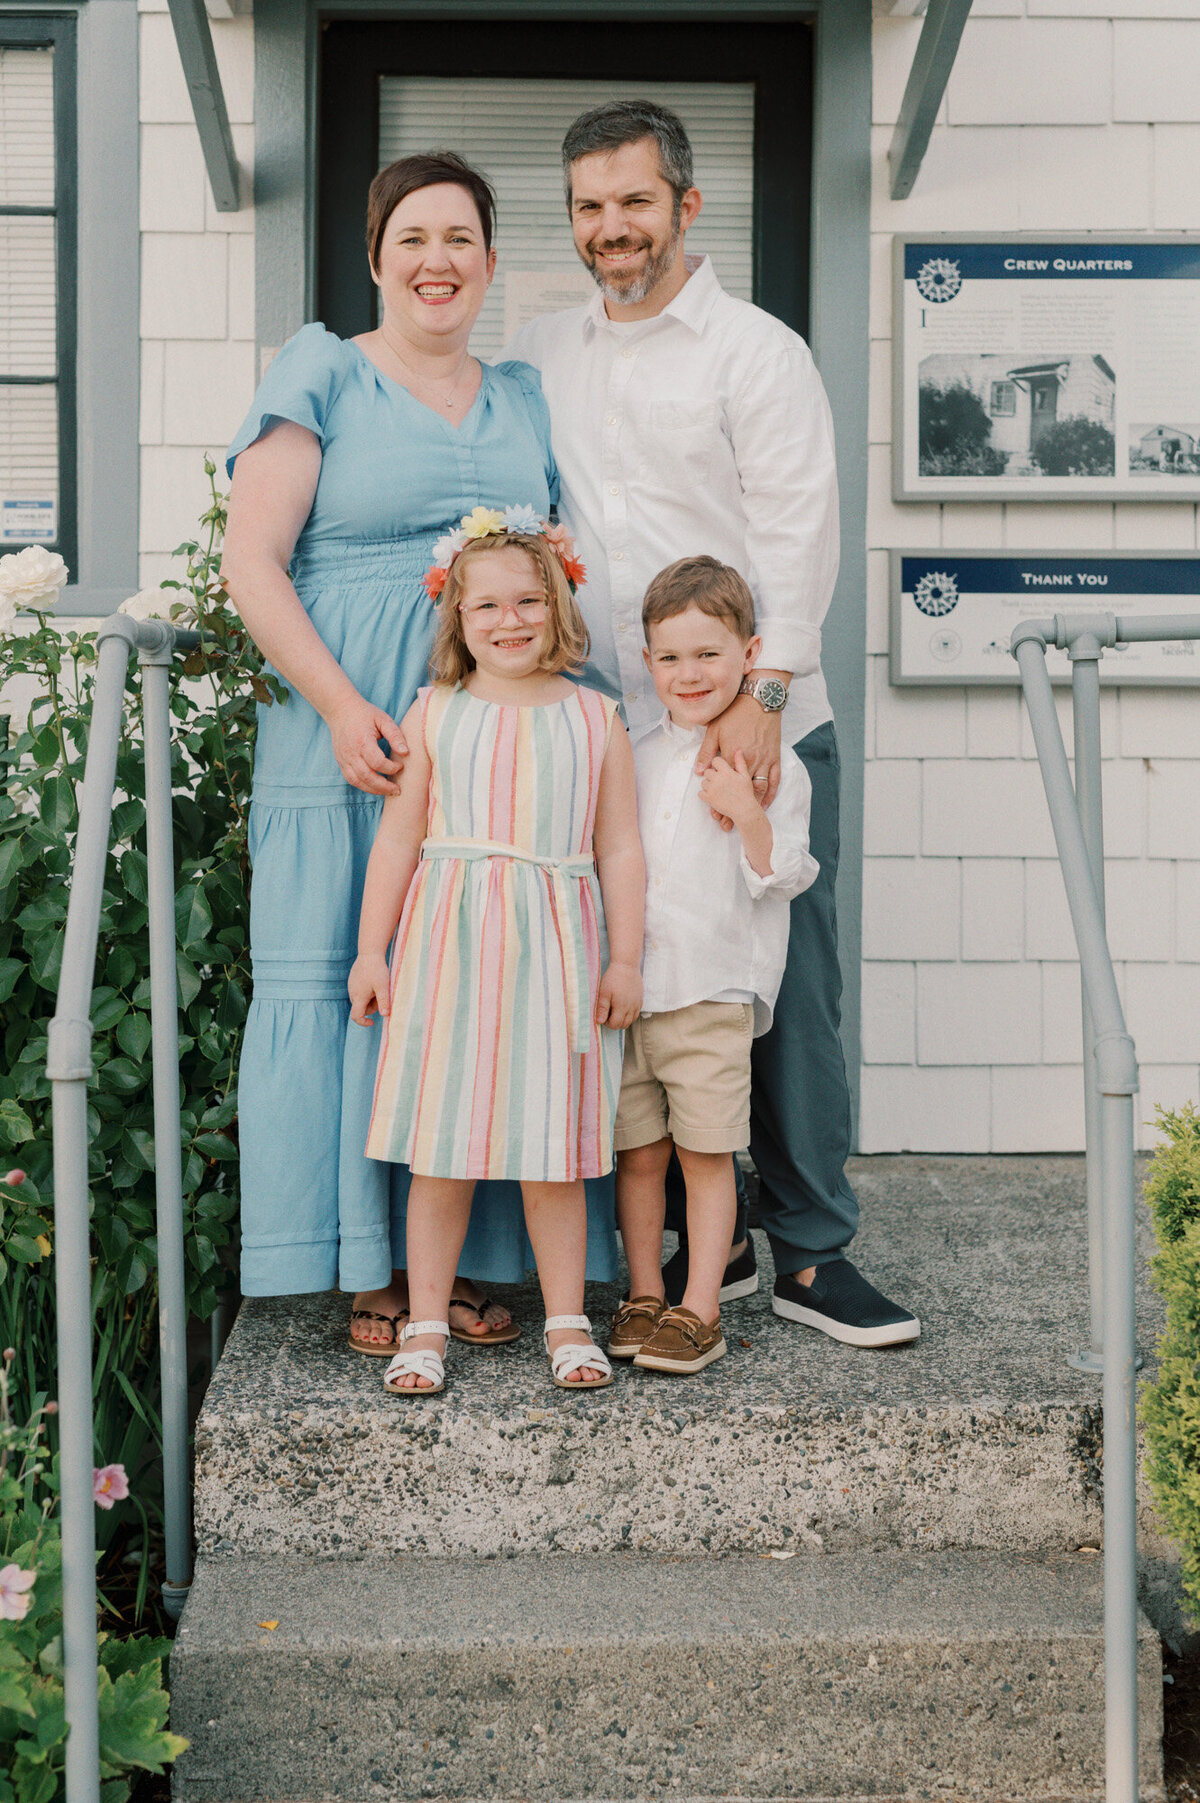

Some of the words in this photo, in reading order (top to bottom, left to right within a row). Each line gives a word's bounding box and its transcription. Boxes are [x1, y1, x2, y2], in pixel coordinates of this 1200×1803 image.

[1003, 258, 1049, 271] CREW
[1053, 258, 1133, 272] QUARTERS
[1021, 572, 1073, 586] THANK
[1077, 572, 1109, 586] YOU
